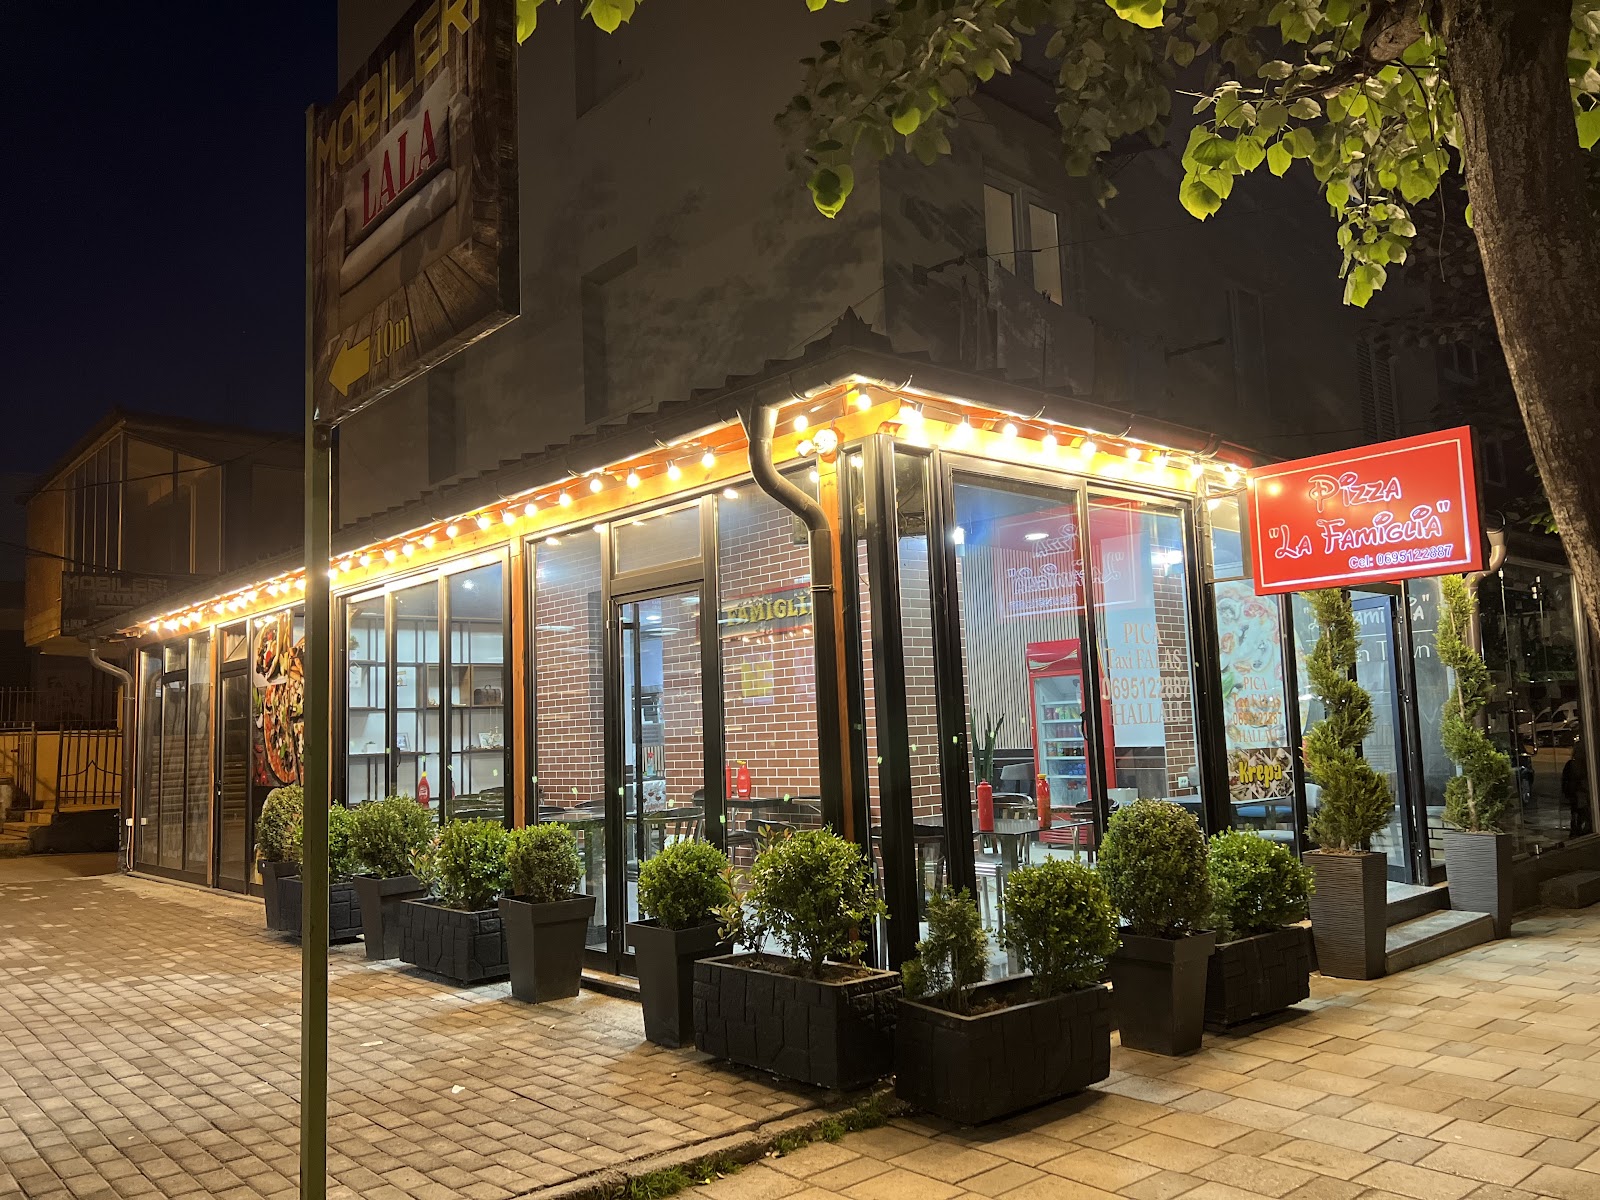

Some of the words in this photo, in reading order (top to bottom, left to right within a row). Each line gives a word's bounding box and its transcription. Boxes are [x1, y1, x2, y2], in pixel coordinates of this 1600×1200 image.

[361, 108, 438, 230] LALA
[374, 312, 411, 366] 10m
[1349, 555, 1374, 569] Cel:
[1376, 543, 1453, 567] 0695122887
[726, 595, 812, 627] FAMIGLI
[1123, 622, 1164, 646] PICA
[1105, 648, 1135, 670] Taxi
[1137, 648, 1182, 670] FALAS
[1102, 676, 1190, 700] 0695122887
[1243, 676, 1268, 691] PICA
[1239, 761, 1283, 788] Krepa
